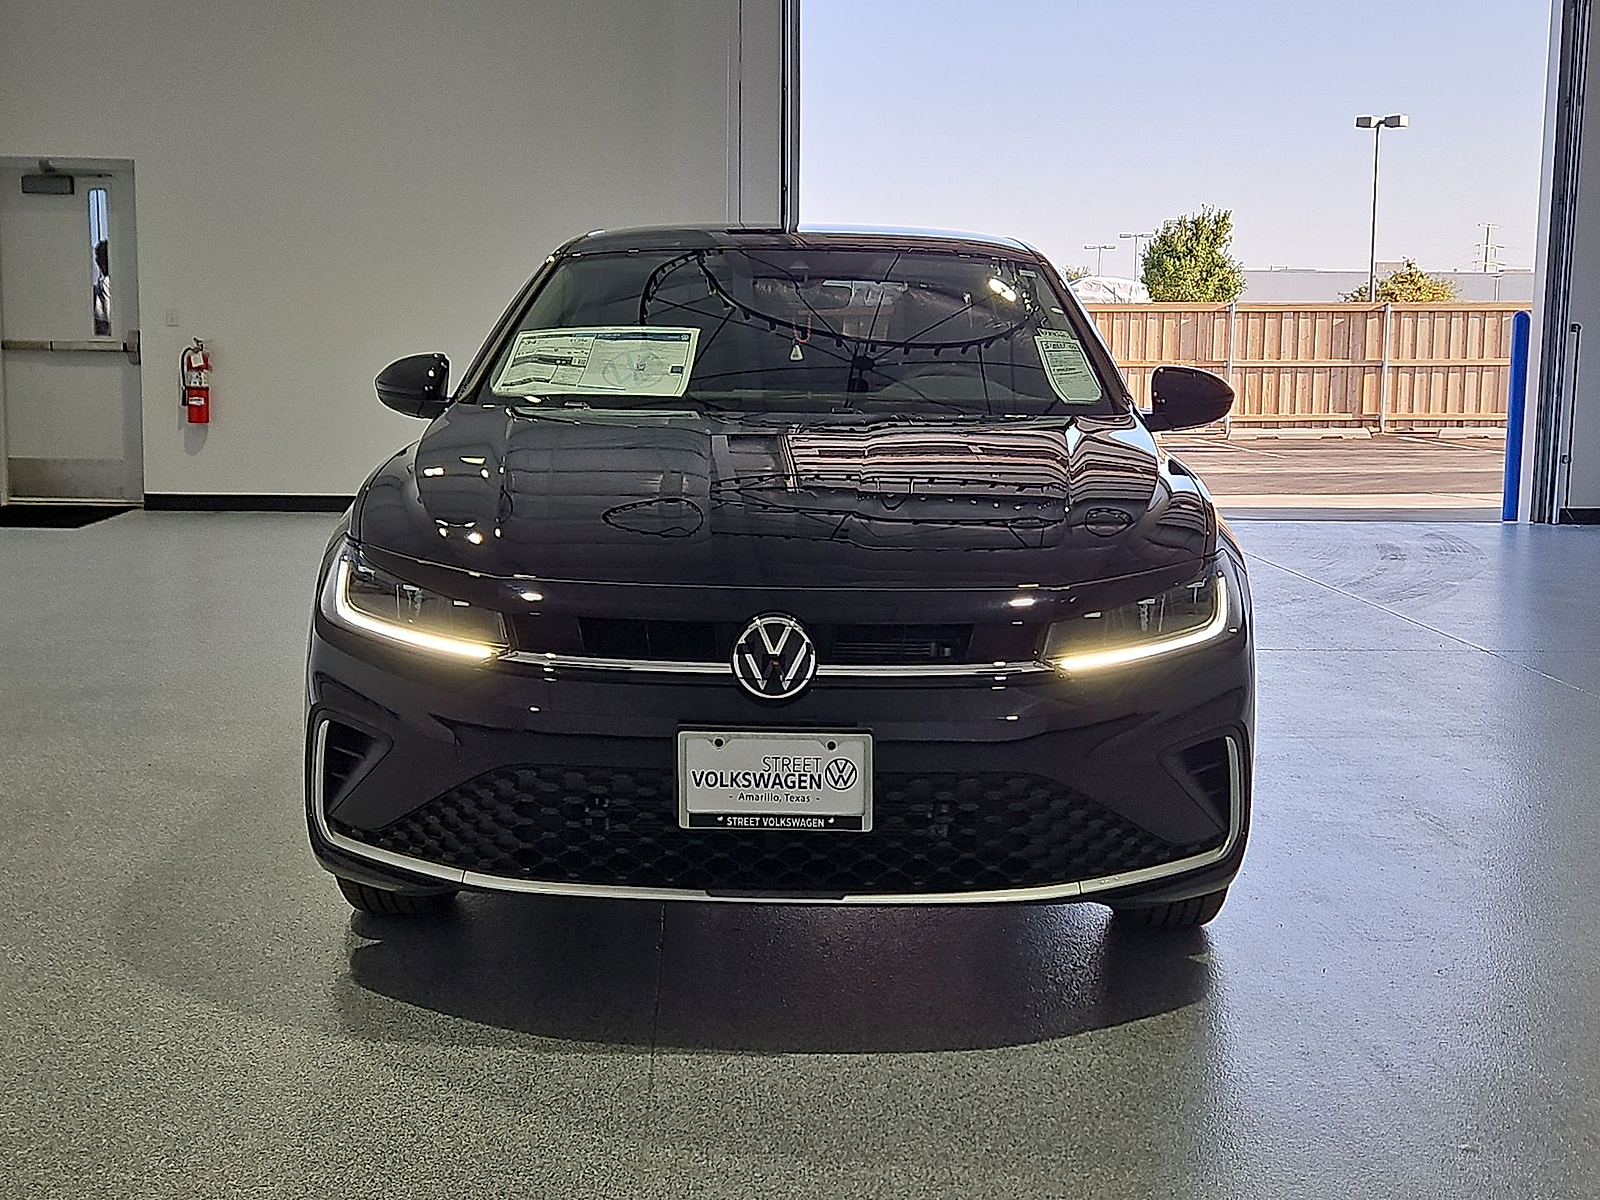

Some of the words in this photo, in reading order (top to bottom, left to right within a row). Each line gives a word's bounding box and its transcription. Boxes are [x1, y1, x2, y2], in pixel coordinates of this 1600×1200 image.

[762, 757, 822, 772] STREET
[691, 771, 822, 790] VOLKSWAGEN
[738, 793, 782, 803] Amarillo,
[784, 794, 811, 803] Texas
[726, 816, 760, 826] STREET
[762, 817, 825, 828] VOLKSWAGEN
